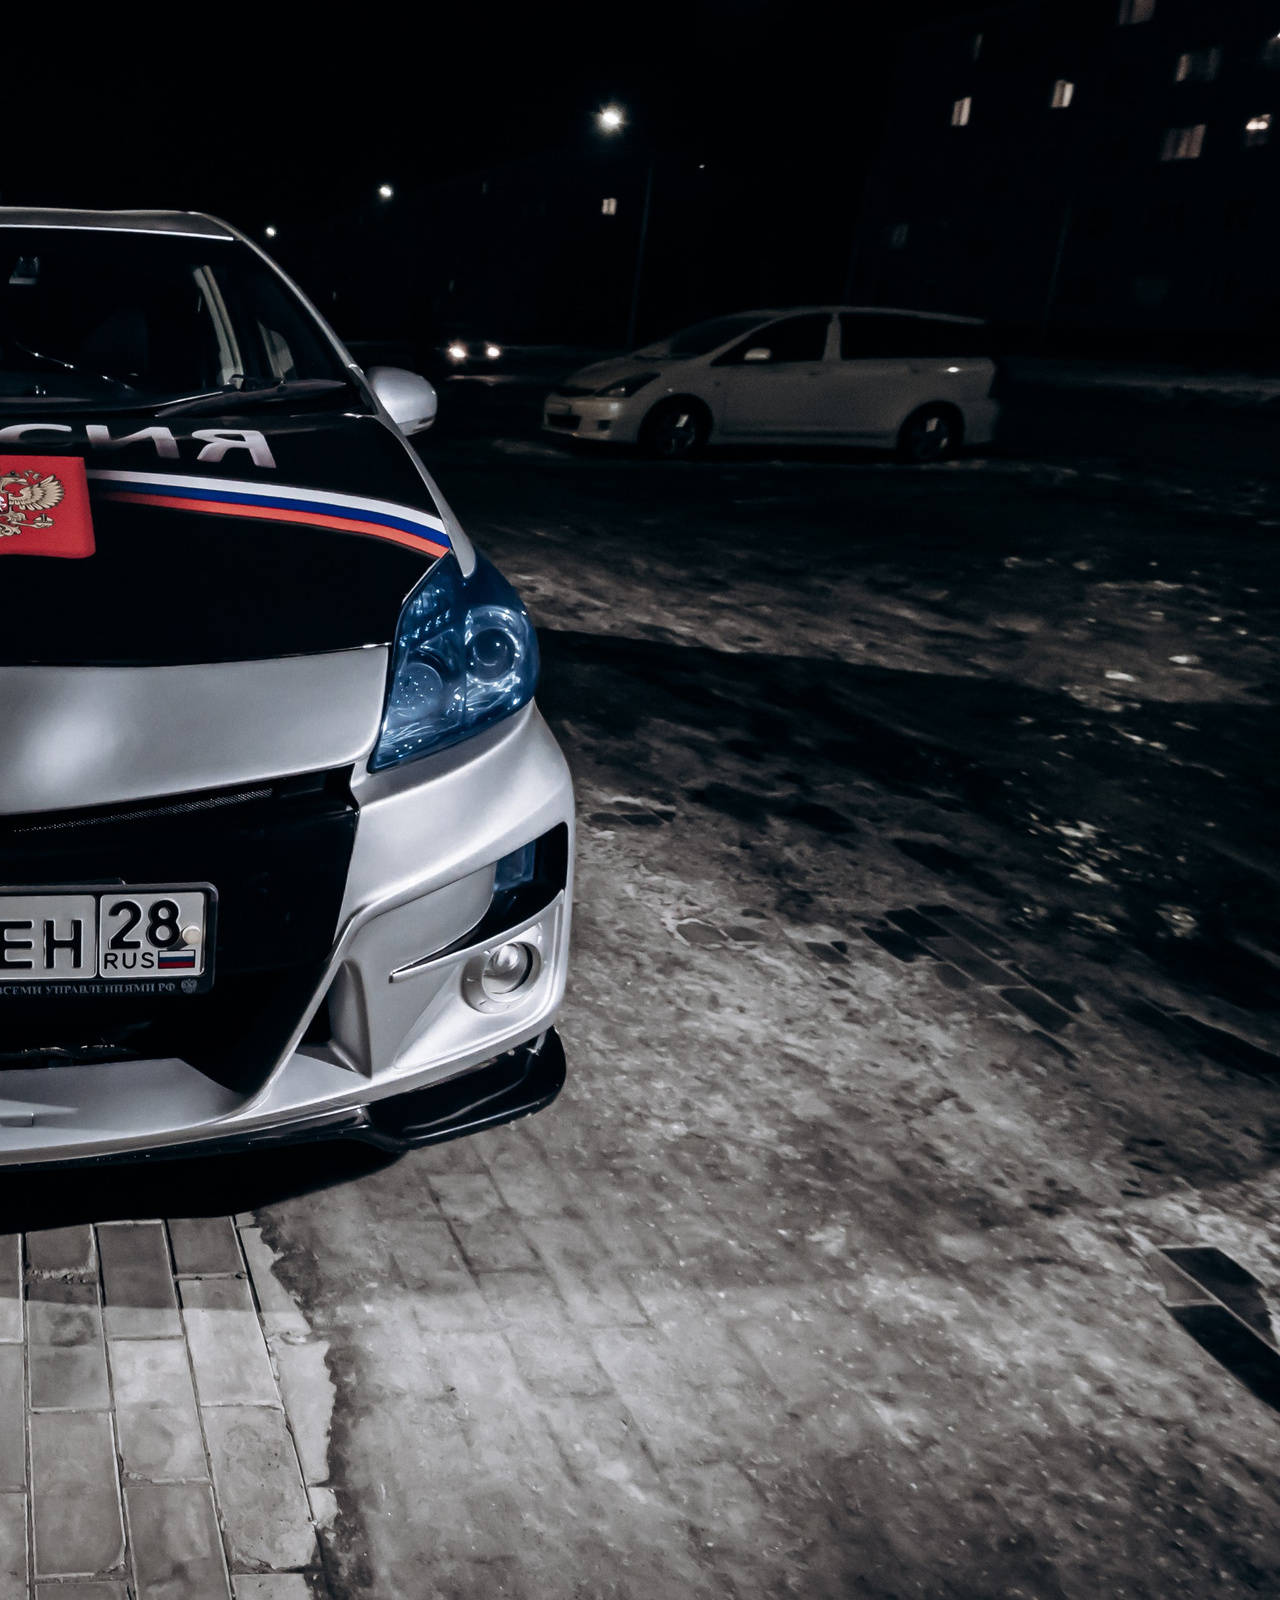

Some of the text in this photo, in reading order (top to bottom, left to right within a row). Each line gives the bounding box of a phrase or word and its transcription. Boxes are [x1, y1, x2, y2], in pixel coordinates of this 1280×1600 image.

[108, 899, 181, 949] 28
[104, 952, 155, 970] RUS
[46, 983, 155, 995] УПРАВЛЕНИЯМИ
[158, 982, 176, 993] РФ
